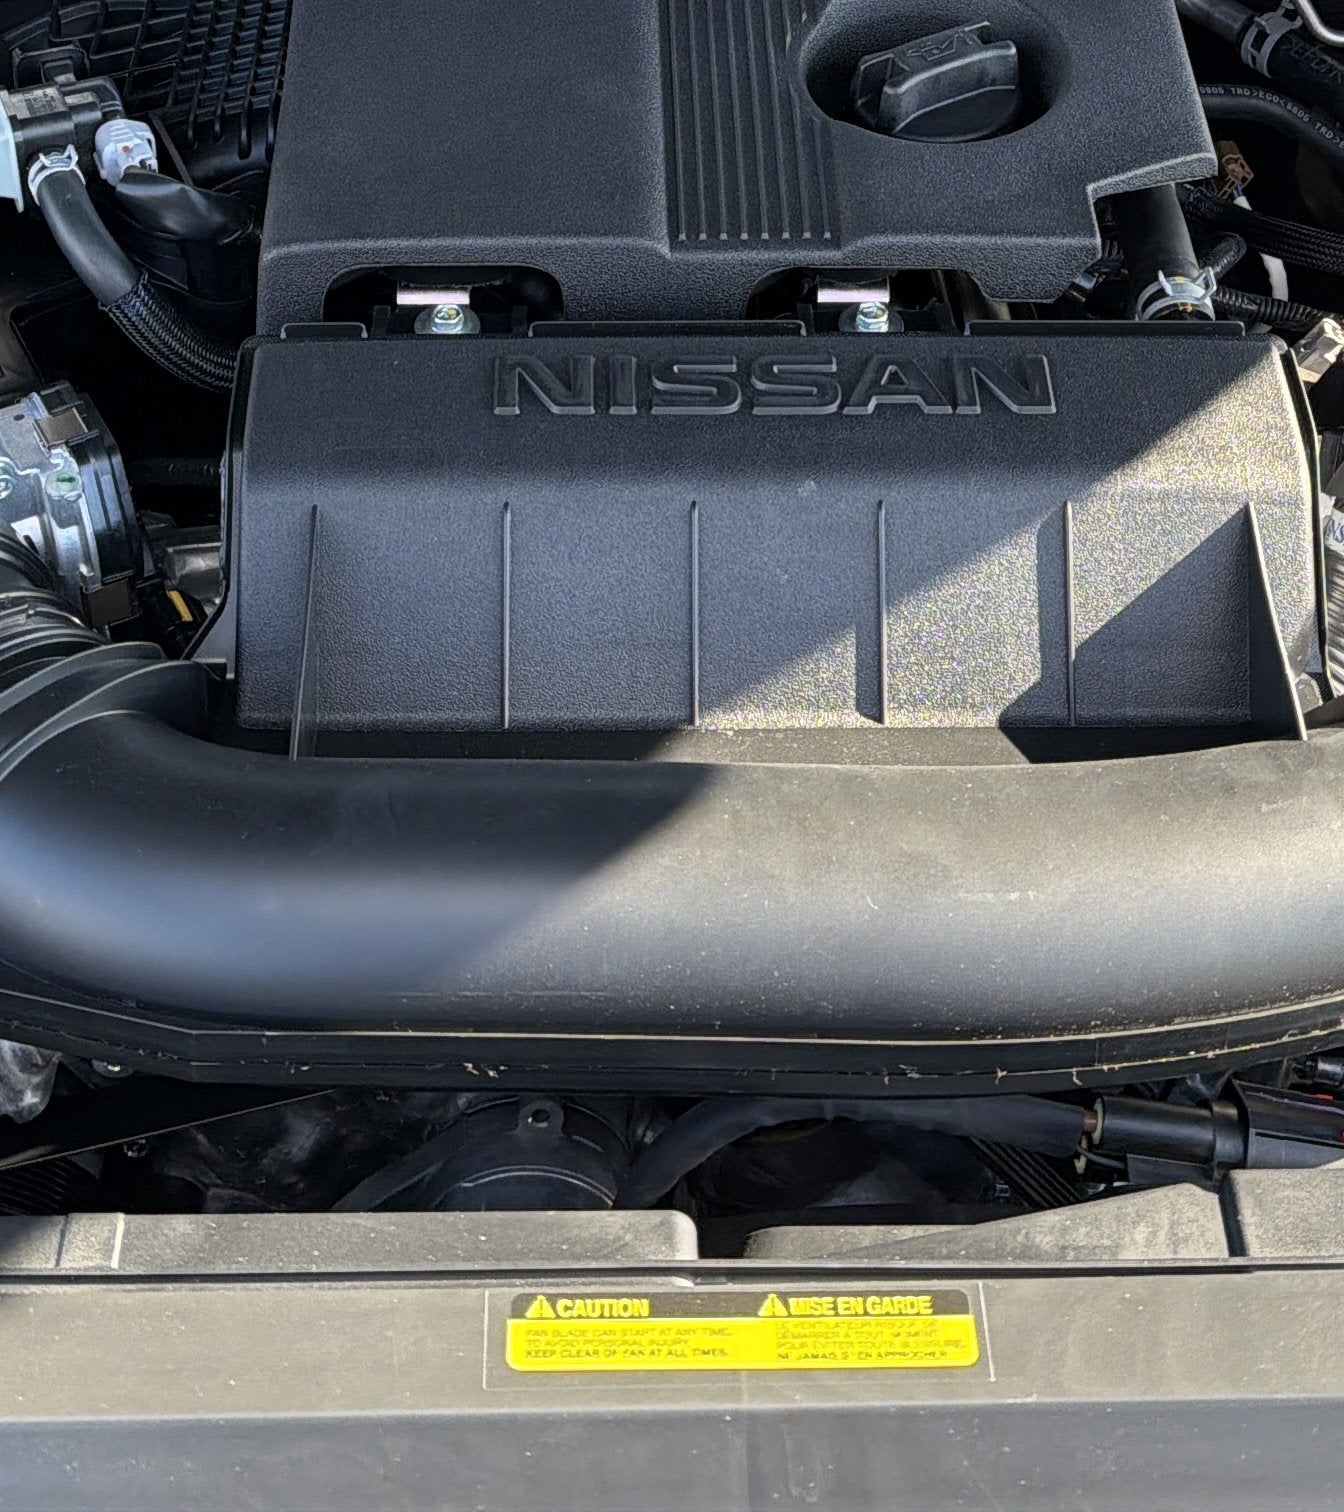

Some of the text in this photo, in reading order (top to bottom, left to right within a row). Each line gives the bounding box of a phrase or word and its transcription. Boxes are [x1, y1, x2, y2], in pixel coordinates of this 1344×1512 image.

[493, 354, 1057, 415] NISSAN
[556, 1298, 650, 1318] CAUTION
[789, 1295, 933, 1316] MISE EN GARDE
[525, 1349, 556, 1358] KEEP
